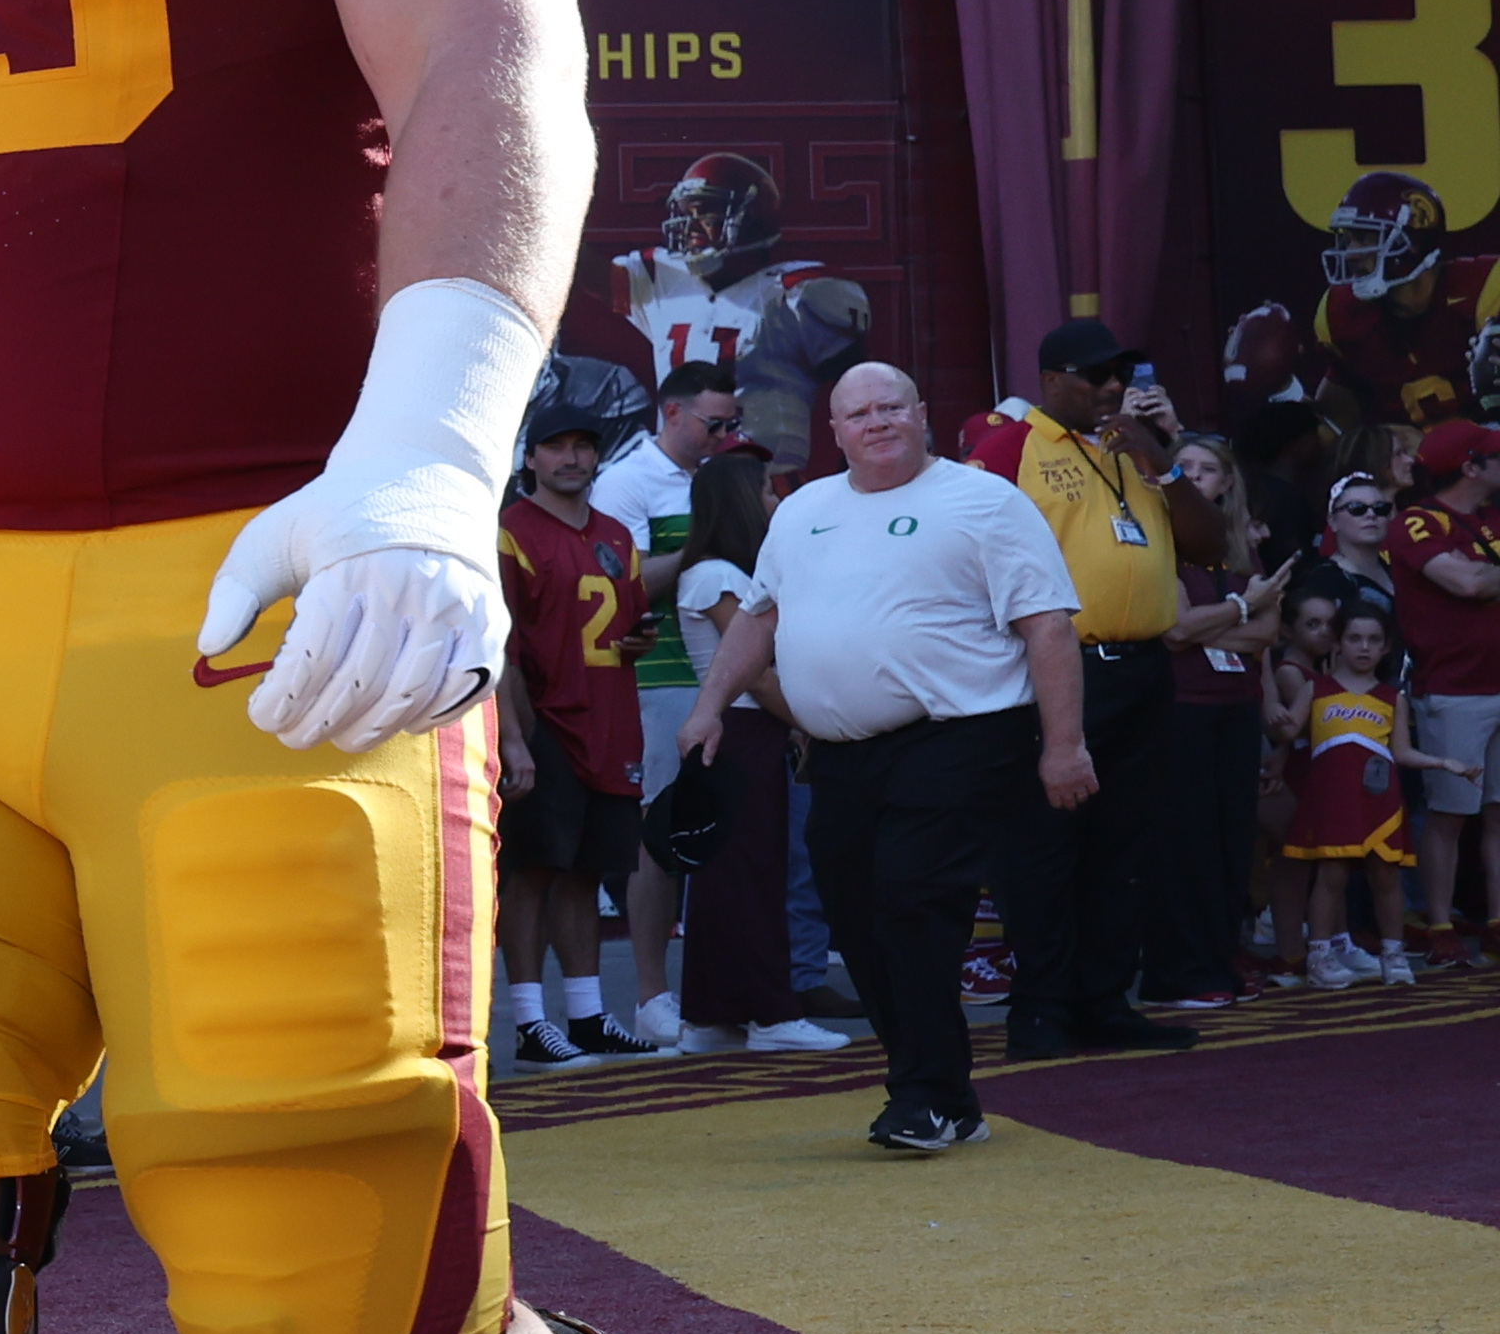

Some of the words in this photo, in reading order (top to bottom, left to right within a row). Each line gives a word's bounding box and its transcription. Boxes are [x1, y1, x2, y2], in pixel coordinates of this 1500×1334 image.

[1040, 466, 1084, 485] 7511
[888, 515, 919, 537] O
[1404, 515, 1430, 543] 2
[577, 573, 622, 668] 2
[1321, 703, 1386, 728] Trojans
